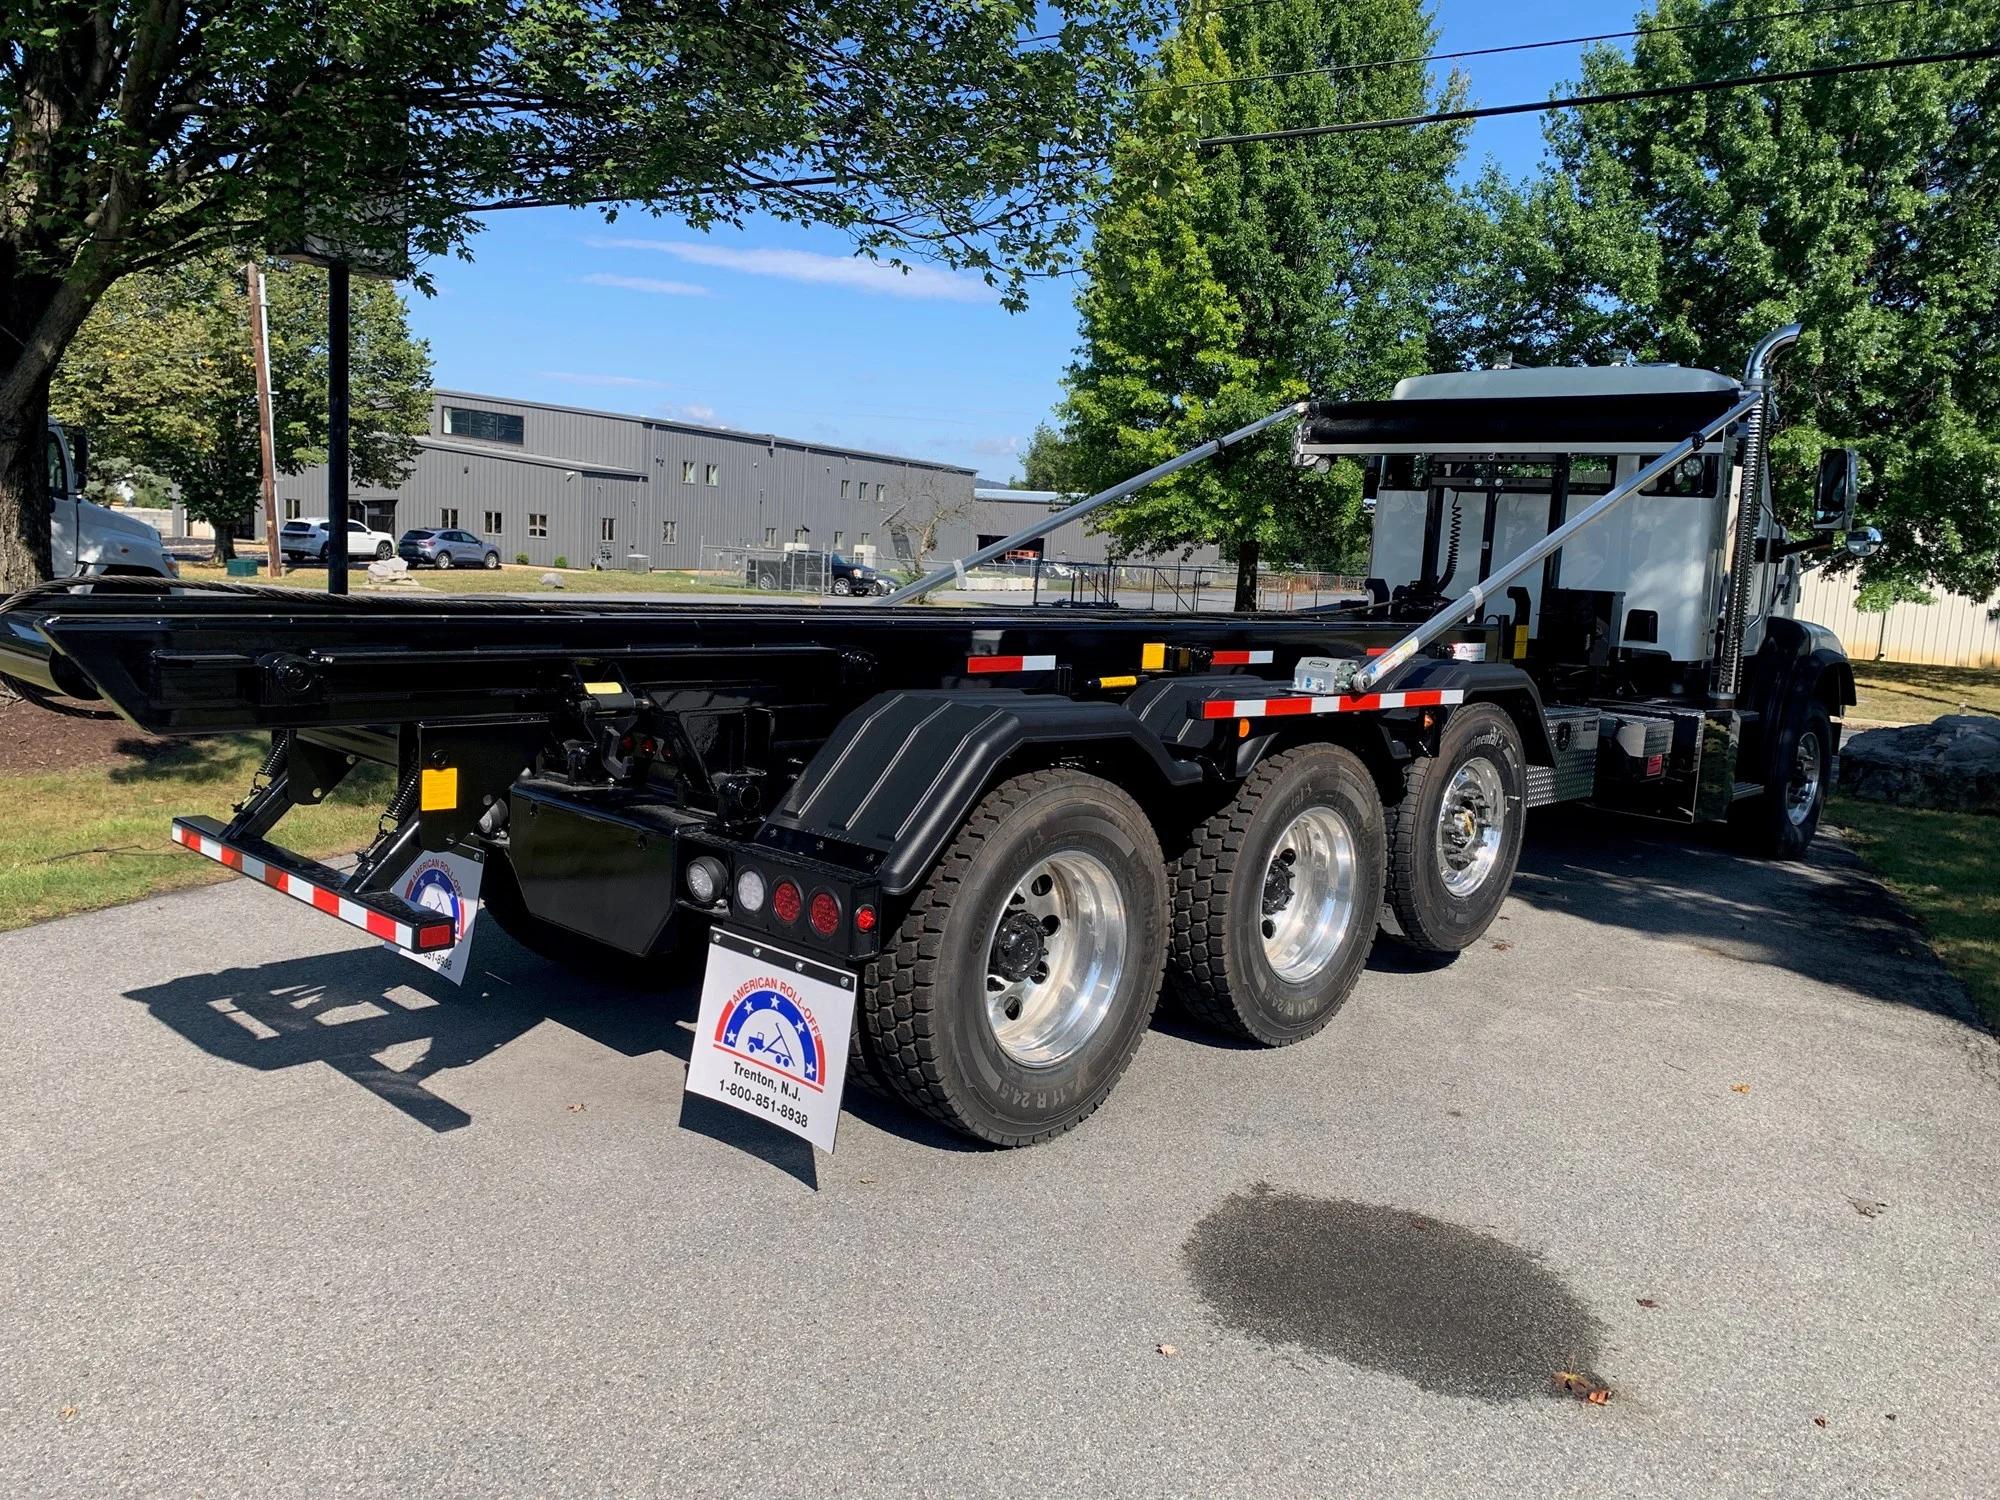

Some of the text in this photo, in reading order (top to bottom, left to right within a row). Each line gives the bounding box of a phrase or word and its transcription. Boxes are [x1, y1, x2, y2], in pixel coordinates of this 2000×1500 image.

[732, 977, 821, 1034] AMERICAN ROLL-OFF
[720, 1079, 808, 1128] 1-800-851-8938
[734, 1061, 801, 1102] Trenton, N.J.
[1036, 1092, 1047, 1109] R
